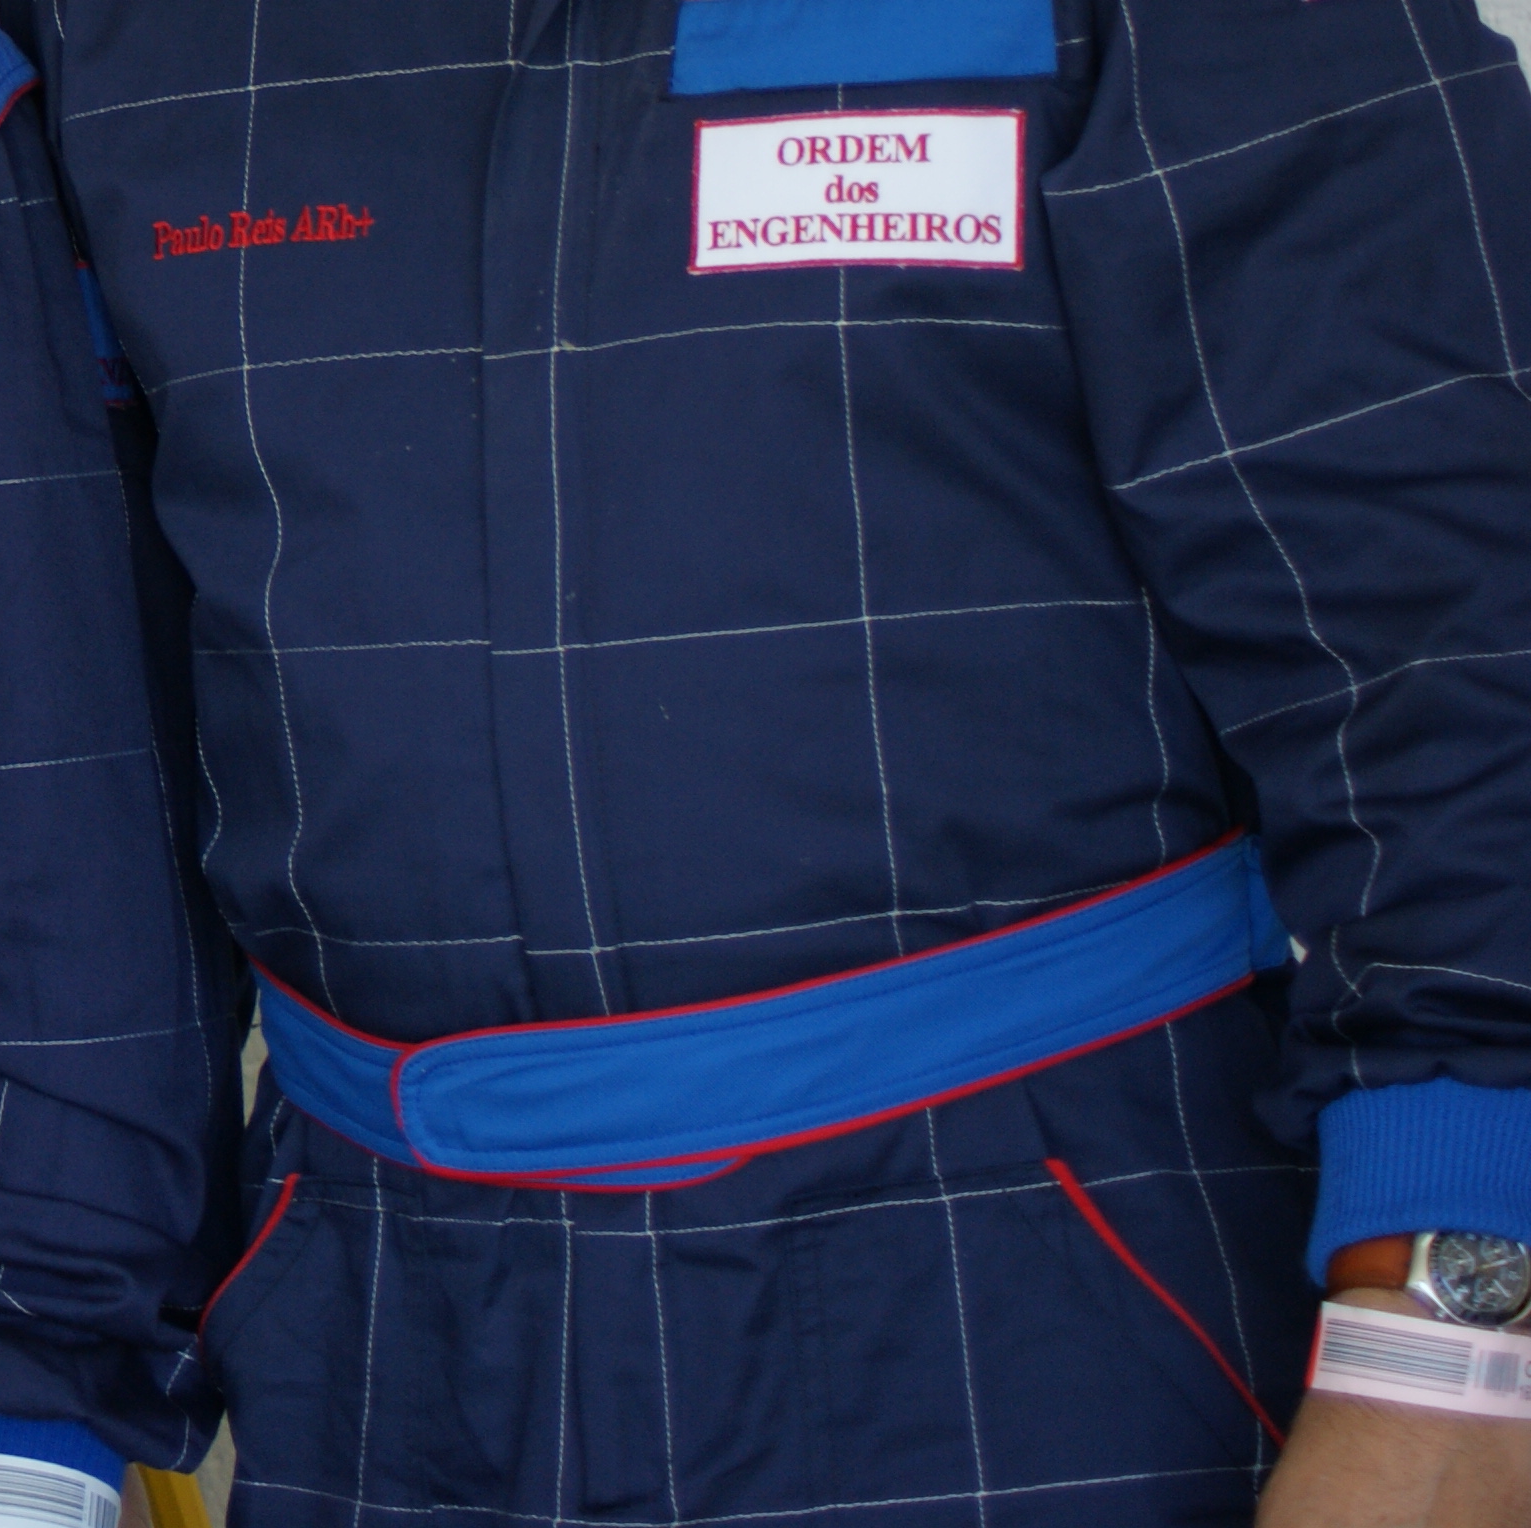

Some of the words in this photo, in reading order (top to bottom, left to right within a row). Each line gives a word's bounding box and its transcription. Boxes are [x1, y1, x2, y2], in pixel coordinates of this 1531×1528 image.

[777, 133, 931, 166] ORDEM
[824, 175, 880, 204] dos
[152, 215, 224, 260] Paulo
[228, 209, 287, 248] Reis
[707, 213, 1002, 250] ENGENHEIROS
